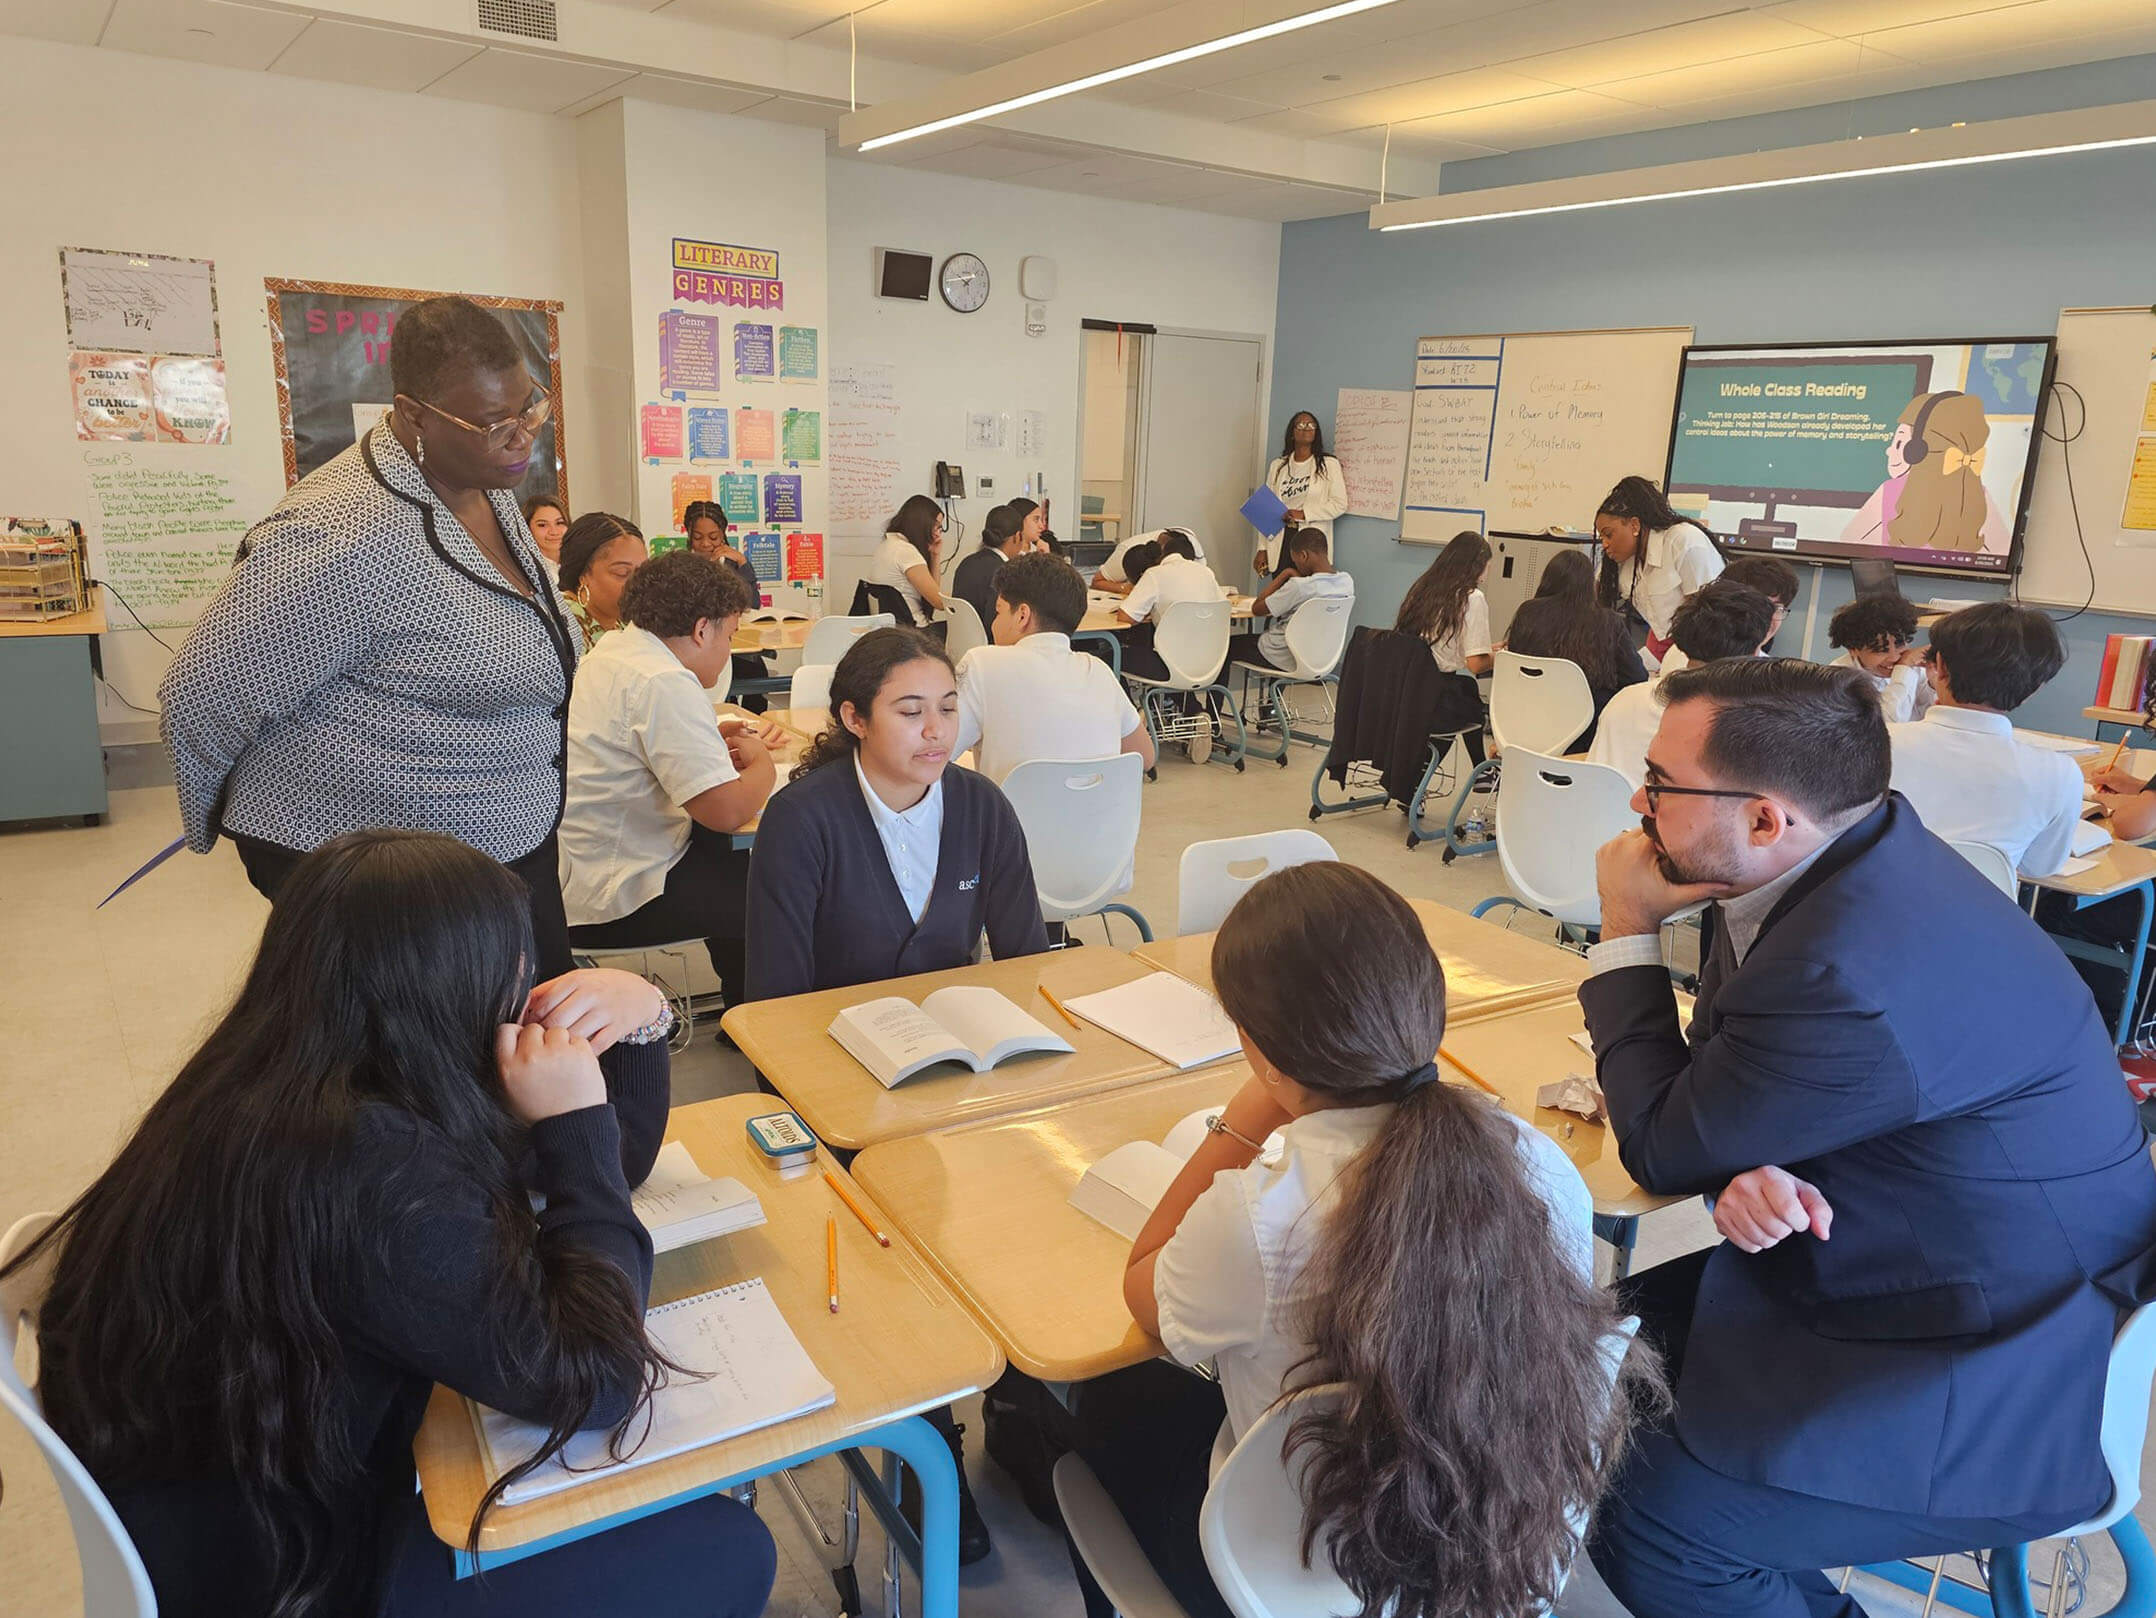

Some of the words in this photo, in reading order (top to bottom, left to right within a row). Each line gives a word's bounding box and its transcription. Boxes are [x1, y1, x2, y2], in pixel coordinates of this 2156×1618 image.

[680, 244, 772, 271] LITERARY
[675, 274, 780, 300] GENRES
[305, 308, 395, 336] SPRI
[679, 316, 706, 326] Genre
[88, 370, 130, 380] TODAY
[1720, 383, 1761, 397] Whole
[1764, 383, 1801, 397] Class
[1805, 383, 1867, 400] Reading
[87, 398, 138, 408] CHANCE
[107, 408, 115, 416] to
[116, 408, 124, 416] be
[1708, 411, 1723, 419] Turn
[1733, 412, 1751, 421] page
[1783, 411, 1790, 419] of
[1791, 412, 1816, 420] Brown
[1817, 412, 1830, 420] Girl
[172, 417, 217, 429] KNOW
[1693, 420, 1720, 429] Thinking
[1767, 421, 1800, 429] Woodson
[1801, 422, 1830, 431] already
[1831, 422, 1871, 431] developed
[1787, 430, 1796, 438] of
[1796, 431, 1828, 440] memory
[959, 874, 980, 890] asc
[768, 1118, 800, 1144] ALTOIDS
